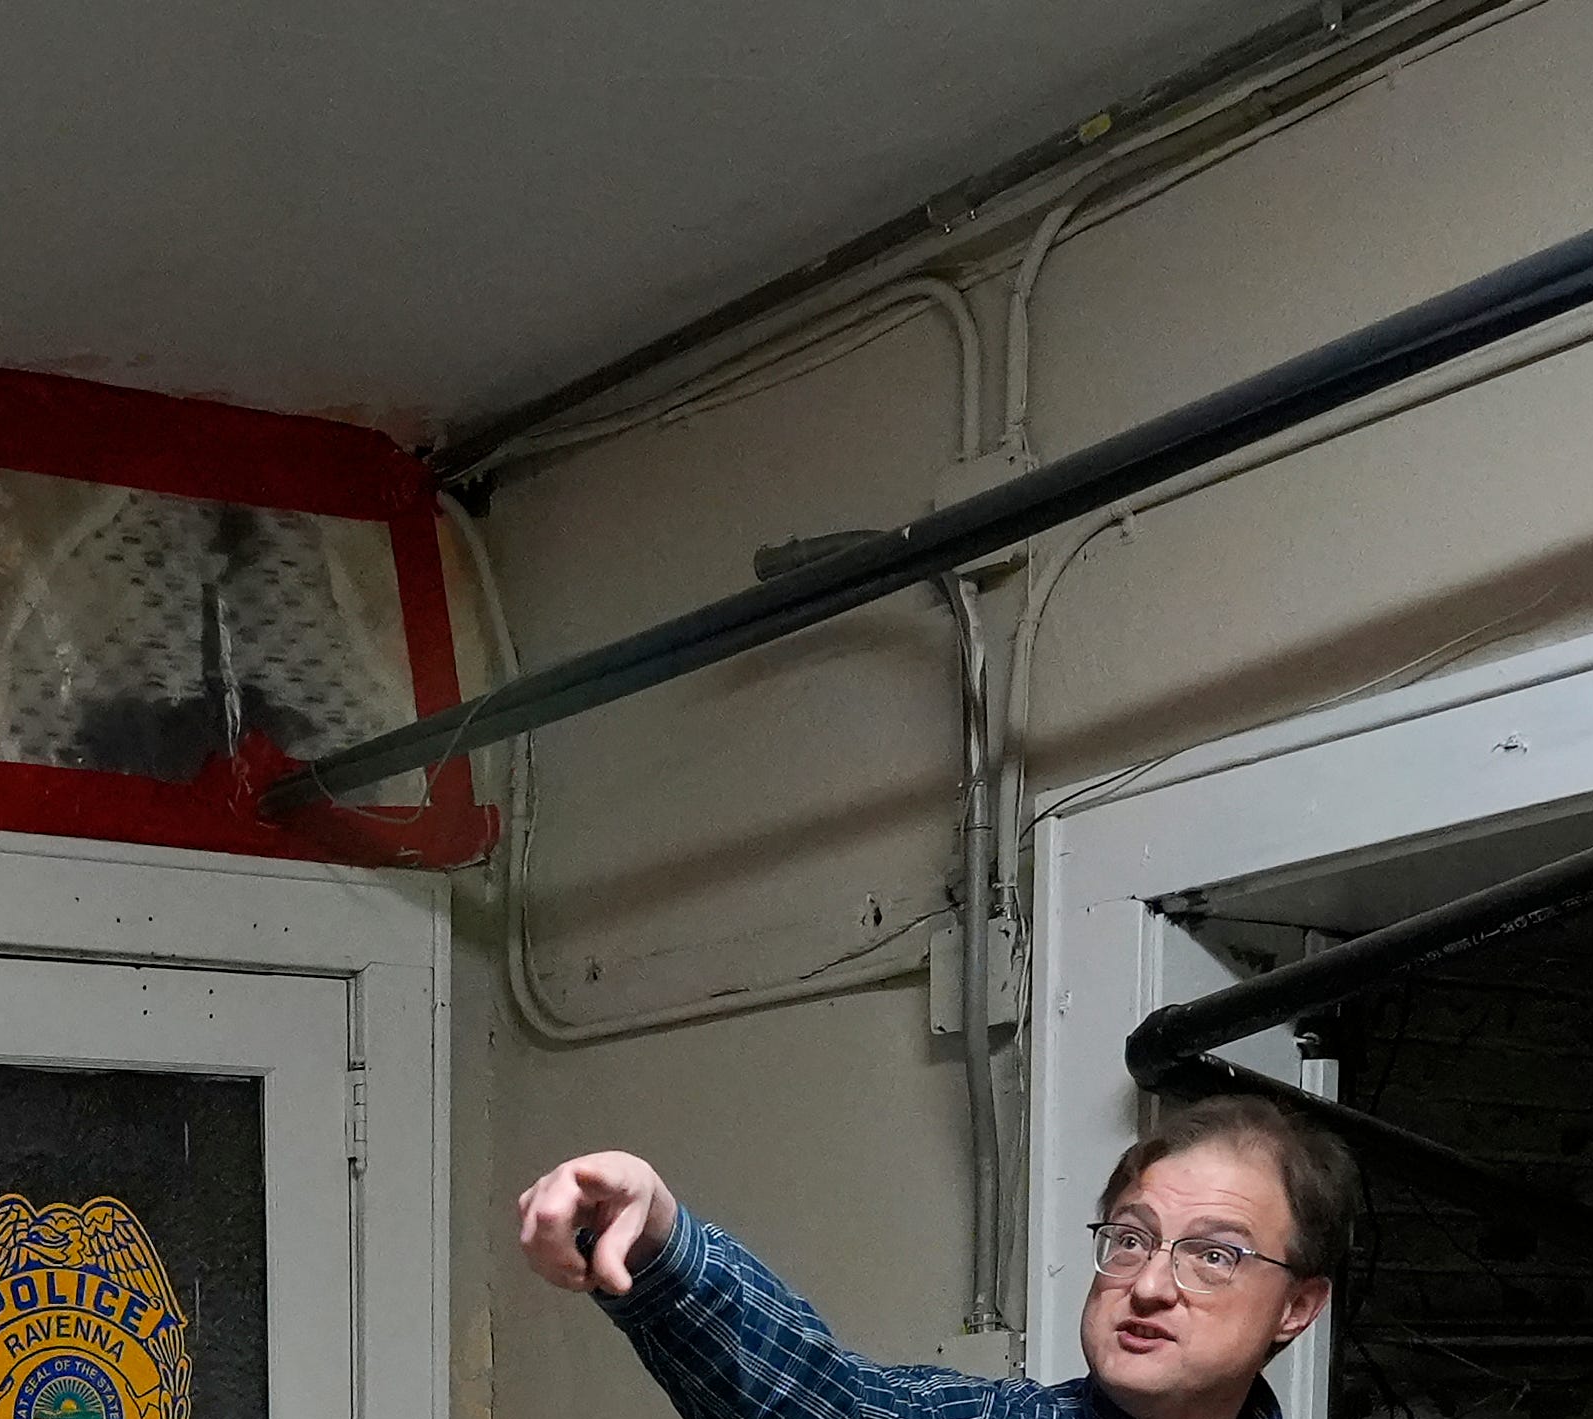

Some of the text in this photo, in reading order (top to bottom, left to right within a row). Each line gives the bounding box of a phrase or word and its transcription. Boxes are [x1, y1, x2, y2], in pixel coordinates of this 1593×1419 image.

[3, 1312, 126, 1364] RAVENNA
[24, 1367, 51, 1396] SEAL
[54, 1359, 72, 1372] OF
[74, 1361, 99, 1380] THE
[96, 1377, 120, 1419] STATE
